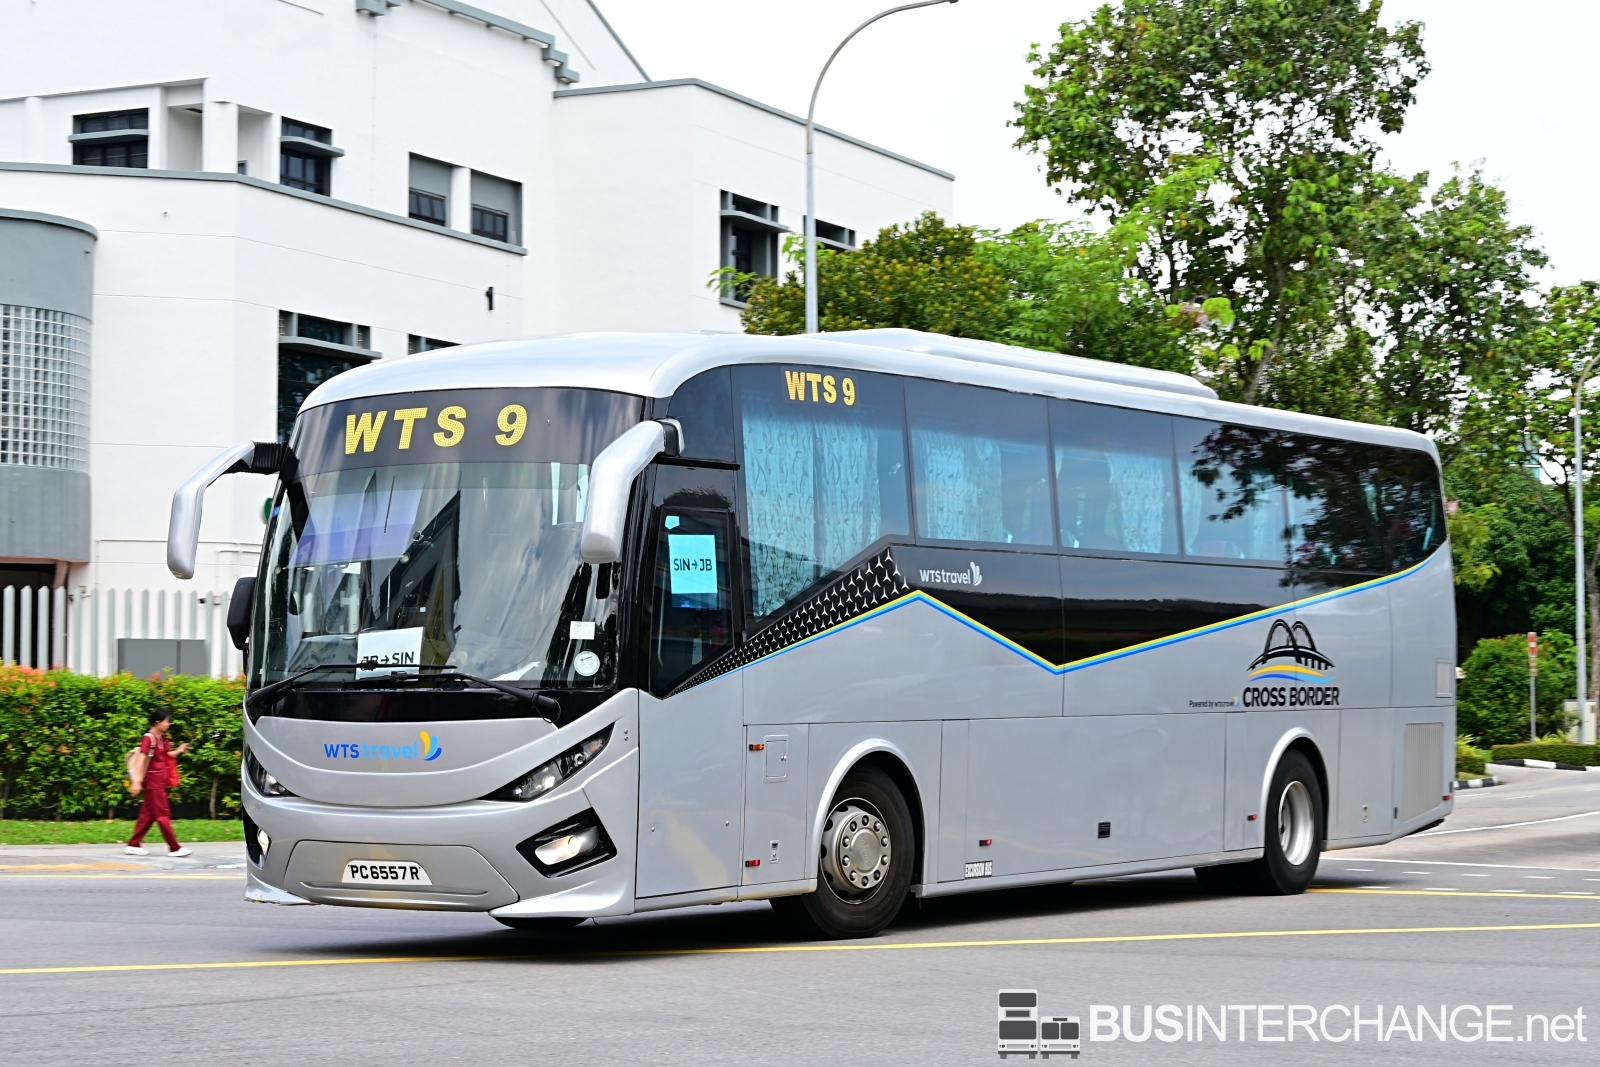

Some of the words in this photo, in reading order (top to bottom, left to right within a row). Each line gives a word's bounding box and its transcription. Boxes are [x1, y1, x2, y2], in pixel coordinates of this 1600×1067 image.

[784, 370, 837, 404] WTS
[842, 377, 856, 406] 9
[345, 405, 467, 455] WTS
[495, 404, 528, 446] 9
[673, 558, 691, 572] SIN
[699, 558, 713, 572] JB
[919, 569, 971, 585] WTStravel
[391, 651, 414, 665] SIN
[1242, 686, 1286, 708] CROSS
[1289, 686, 1340, 707] BORDER
[349, 864, 420, 881] PC6557R
